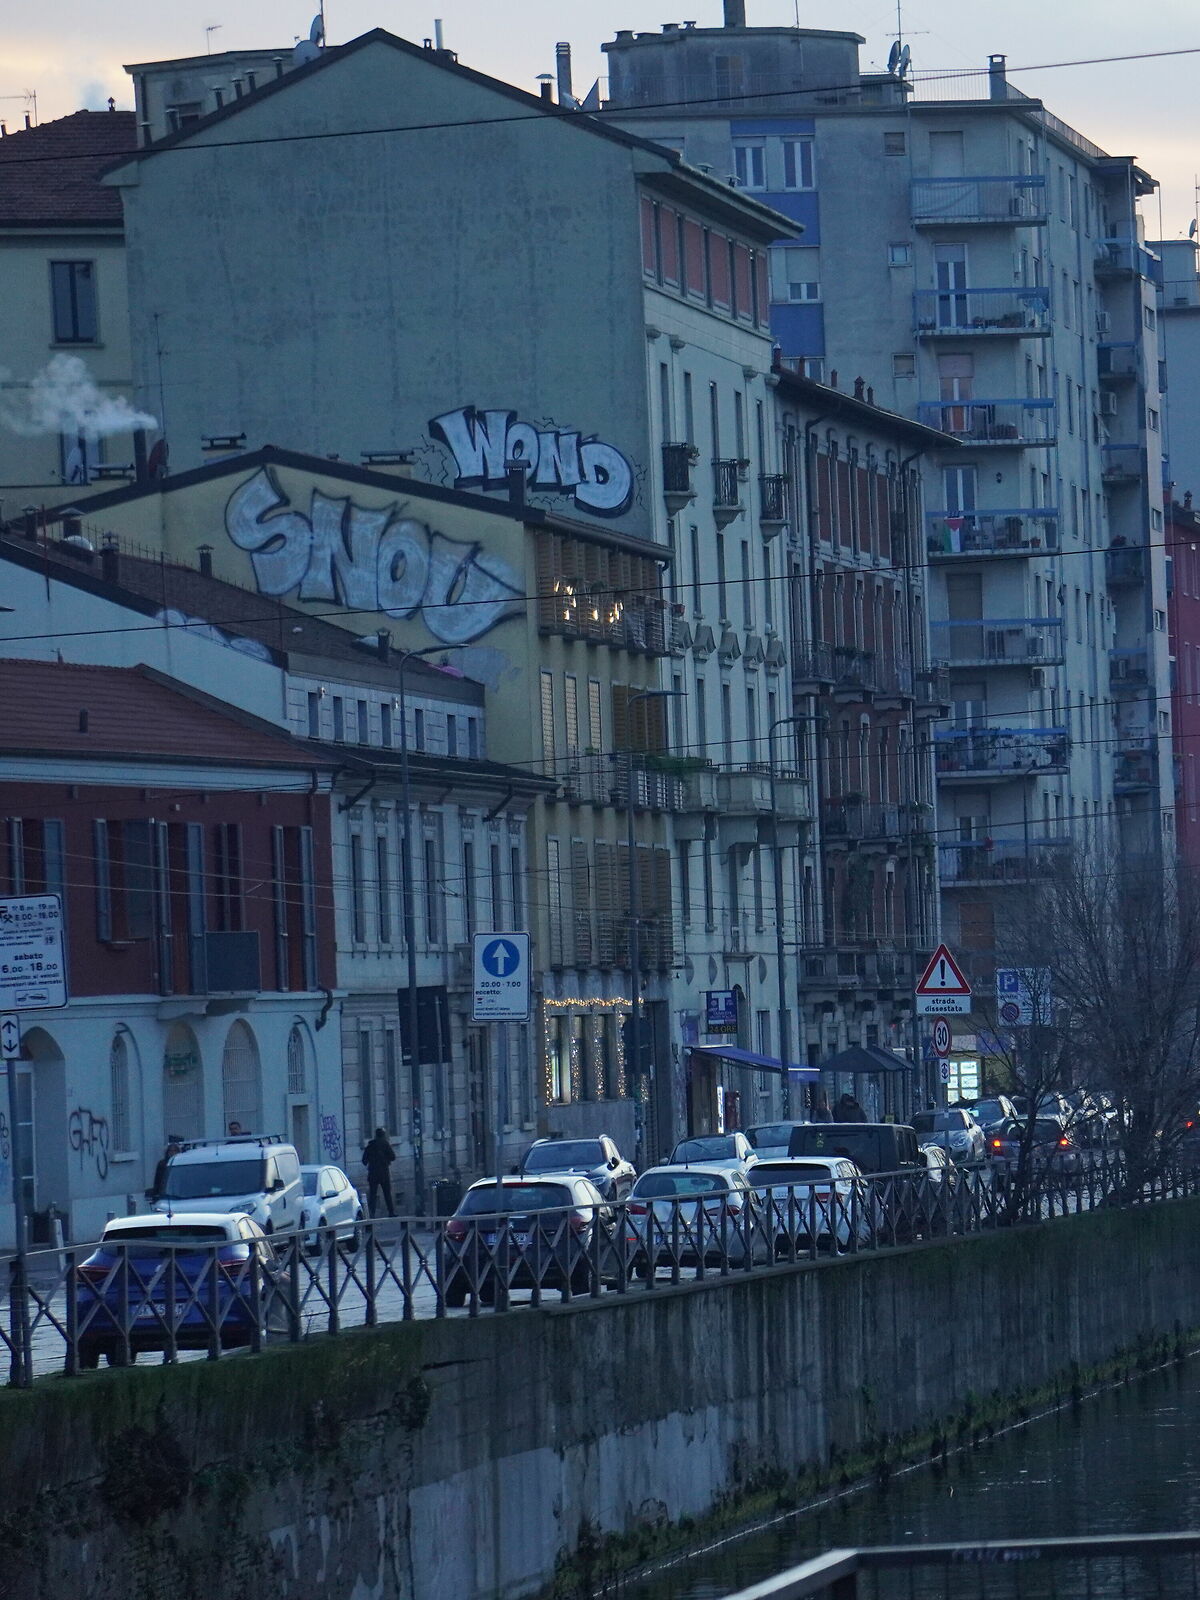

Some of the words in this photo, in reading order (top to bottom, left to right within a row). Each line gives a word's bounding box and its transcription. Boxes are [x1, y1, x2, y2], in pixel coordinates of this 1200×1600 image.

[14, 953, 43, 961] sabato
[30, 962, 57, 972] 18.00
[1003, 974, 1015, 990] P
[711, 992, 731, 1011] T
[937, 1026, 948, 1046] 30
